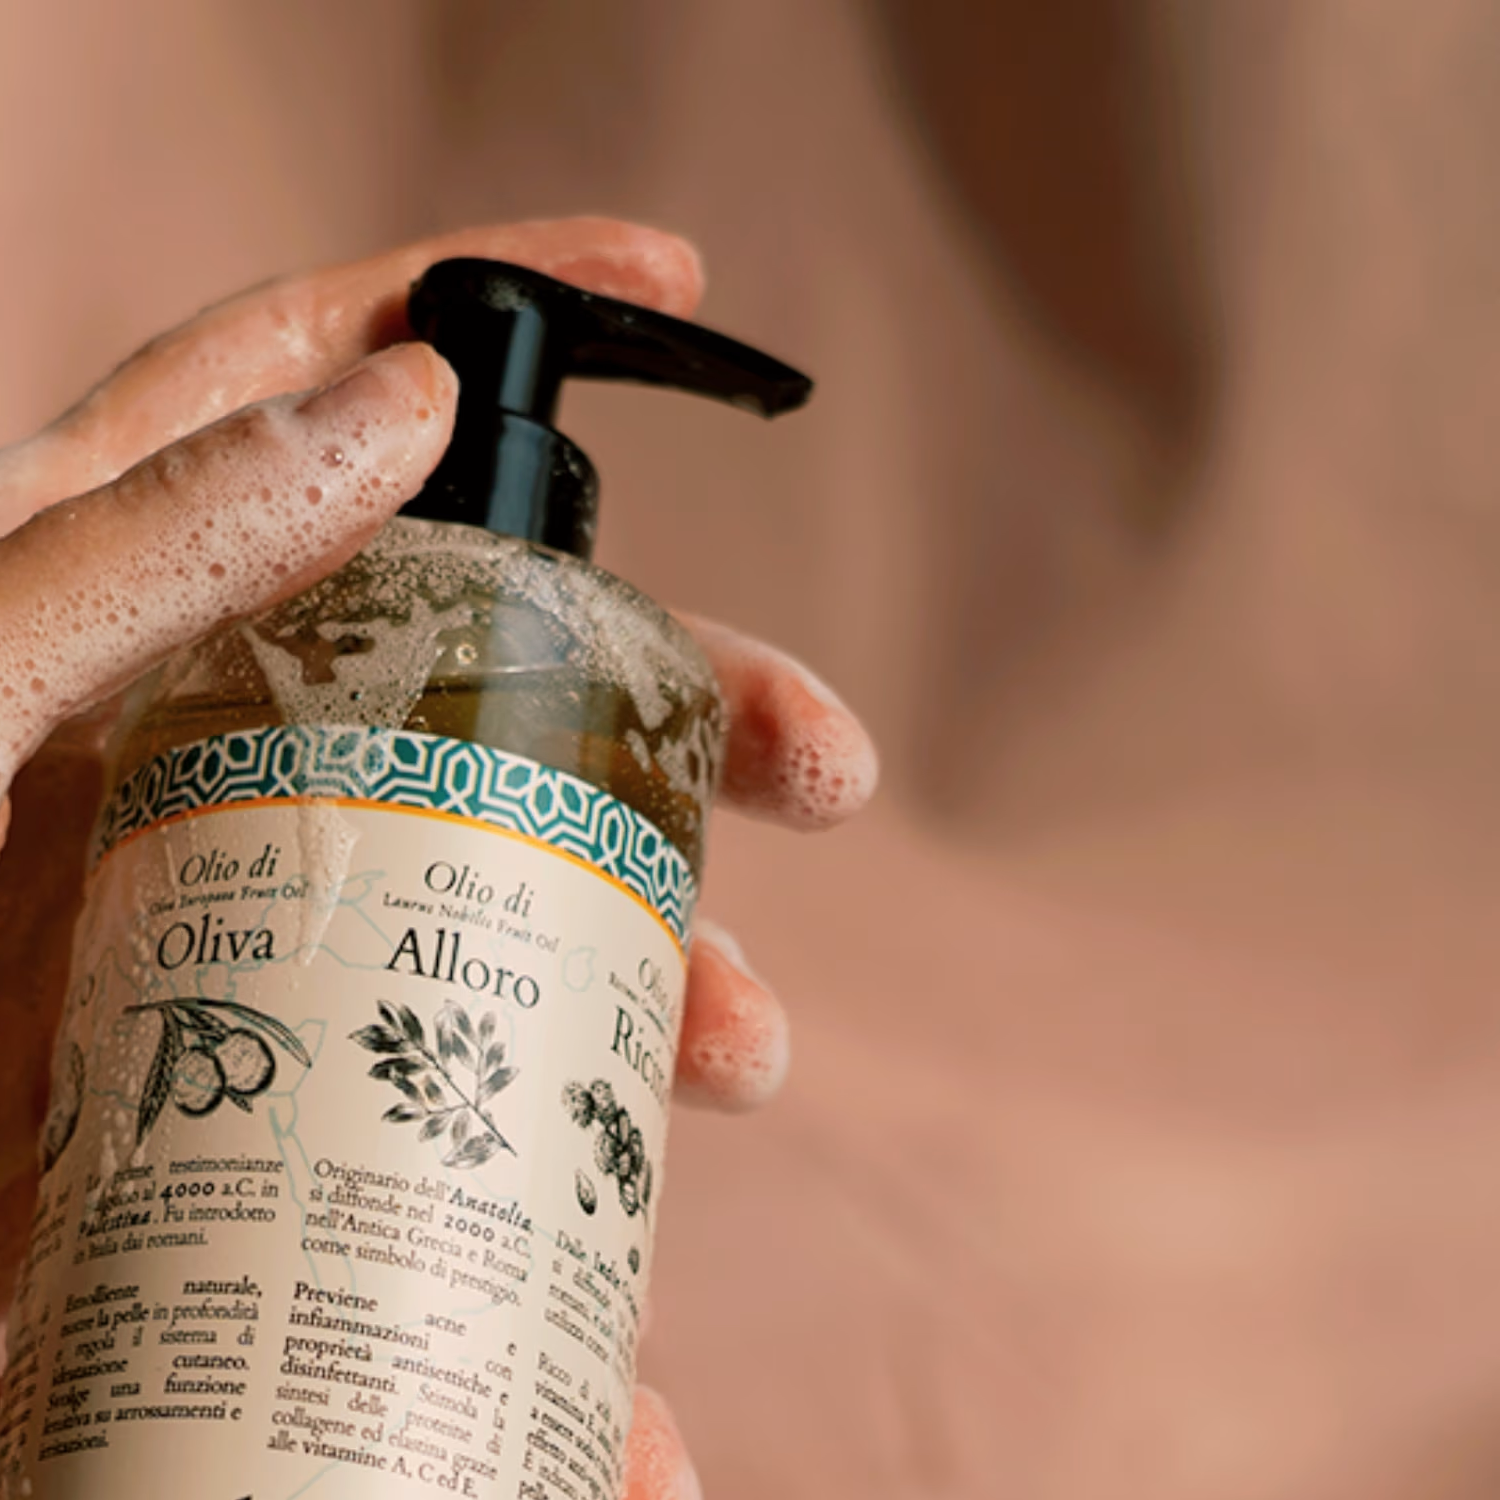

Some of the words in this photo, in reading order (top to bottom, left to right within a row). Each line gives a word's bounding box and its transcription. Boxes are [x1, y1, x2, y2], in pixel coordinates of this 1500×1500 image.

[180, 848, 240, 886] Olio
[248, 843, 281, 879] di
[424, 861, 495, 904] Olio
[503, 882, 534, 918] di
[157, 913, 274, 970] Oliva
[383, 891, 434, 915] Laurus
[535, 933, 560, 954] Oil
[384, 926, 540, 1009] Alloro
[159, 1182, 216, 1207] 4000
[261, 1179, 280, 1199] in
[168, 1154, 285, 1176] testimonianze
[313, 1158, 410, 1193] Originario
[122, 1231, 144, 1253] dai
[146, 1227, 209, 1249] romani.
[163, 1203, 184, 1223] Fu
[188, 1200, 276, 1223] introdotto
[308, 1184, 323, 1202] si
[327, 1184, 402, 1216] diffonde
[406, 1203, 434, 1224] nel
[443, 1213, 496, 1243] 2000
[301, 1236, 351, 1257] come
[355, 1241, 426, 1273] simbolo
[430, 1258, 448, 1281] di
[449, 1267, 522, 1307] prestigio.
[305, 1209, 401, 1241] nell'Antica
[407, 1226, 463, 1259] Grecia
[466, 1250, 479, 1265] e
[482, 1248, 528, 1283] Roma
[97, 1308, 110, 1328] la
[111, 1301, 149, 1331] pelle
[153, 1303, 168, 1321] in
[172, 1297, 259, 1325] profondità
[183, 1275, 262, 1298] naturale,
[132, 1326, 144, 1347] il
[158, 1326, 217, 1345] sistema
[237, 1325, 255, 1346] di
[288, 1305, 430, 1351] infiammazioni
[485, 1359, 513, 1382] con
[293, 1281, 378, 1312] Previene
[424, 1312, 467, 1336] acne
[506, 1342, 518, 1357] e
[110, 1381, 141, 1398] una
[163, 1372, 247, 1395] funzione
[172, 1354, 251, 1371] cutaneo.
[283, 1335, 373, 1363] proprietà
[392, 1353, 493, 1399] antisettiche
[499, 1392, 510, 1406] e
[94, 1408, 112, 1425] su
[114, 1400, 228, 1421] arrossamenti
[230, 1406, 243, 1421] e
[275, 1382, 331, 1406] sintesi
[347, 1392, 389, 1417] delle
[404, 1410, 473, 1444] proteine
[486, 1432, 501, 1456] di
[280, 1355, 400, 1395] disinfettanti.
[418, 1382, 478, 1420] Stimola
[493, 1408, 506, 1431] la
[267, 1430, 298, 1453] alle
[302, 1437, 388, 1470] vitamine
[391, 1456, 413, 1479] A,
[418, 1462, 435, 1483] C
[437, 1471, 460, 1492] ed
[461, 1477, 479, 1499] E.
[271, 1406, 356, 1438] collagene
[360, 1422, 384, 1443] ed
[388, 1429, 448, 1460] elastina
[450, 1453, 498, 1482] grazie
